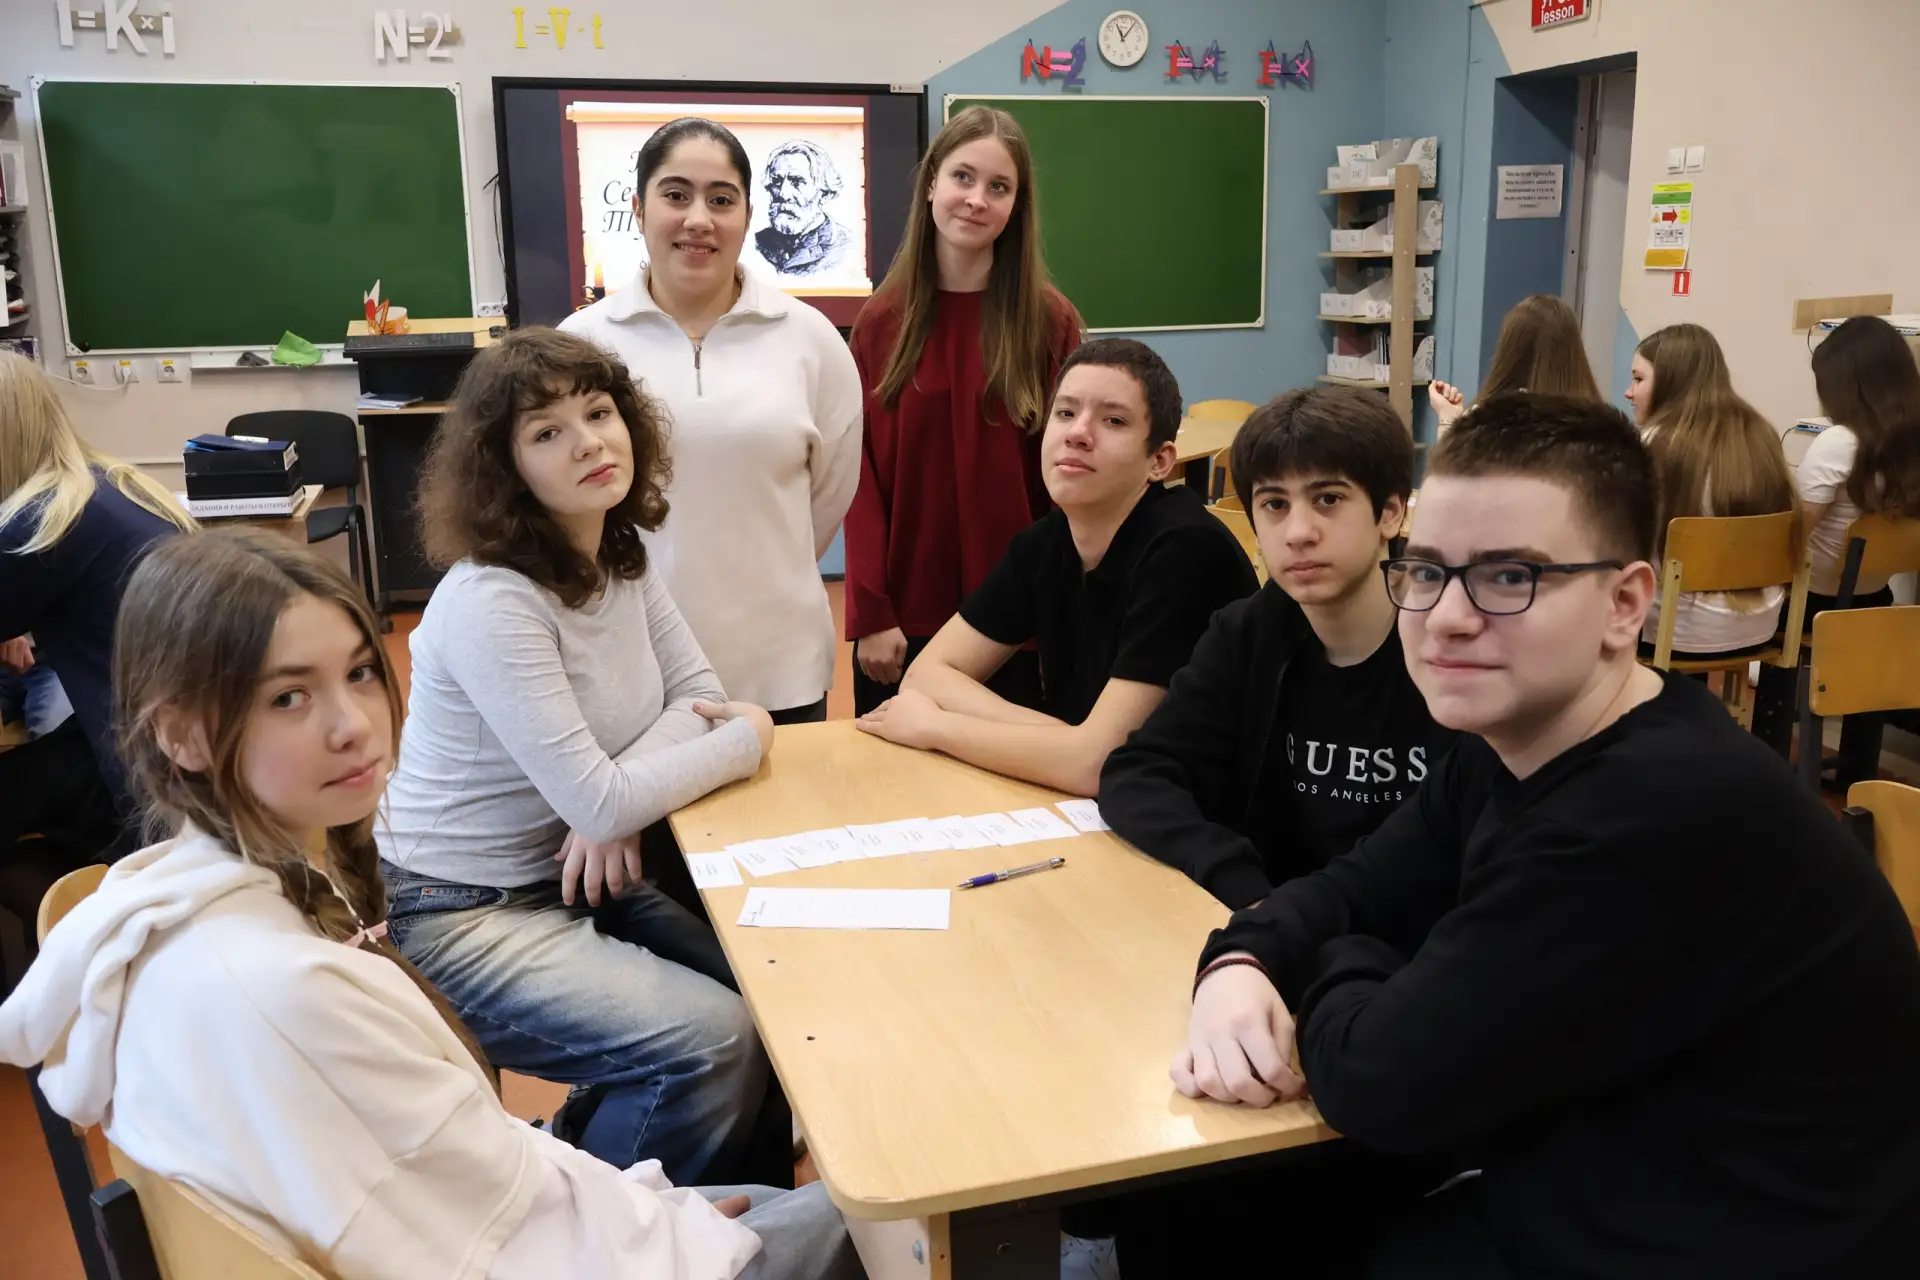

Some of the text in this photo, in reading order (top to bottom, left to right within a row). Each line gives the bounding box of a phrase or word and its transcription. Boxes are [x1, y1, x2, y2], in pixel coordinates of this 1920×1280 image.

[1541, 5, 1574, 24] lesson
[1286, 733, 1428, 783] GUESS
[1331, 788, 1402, 803] ANGELES
